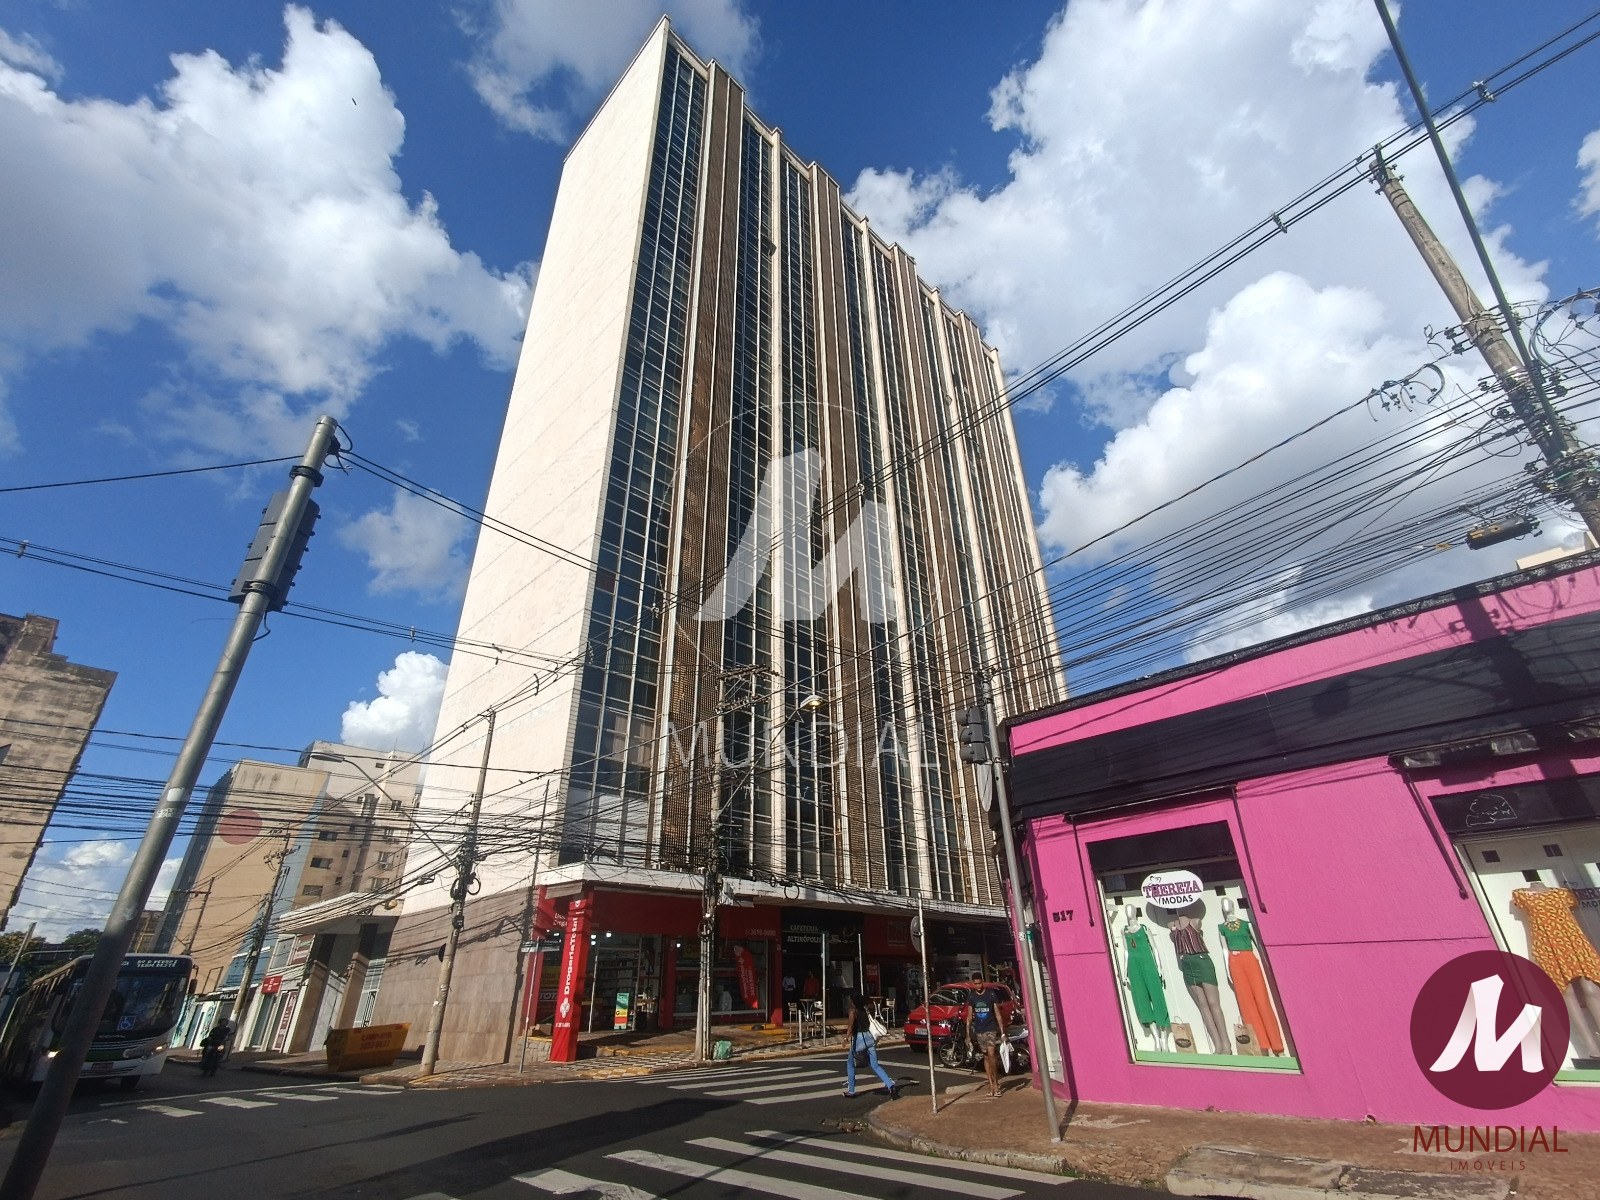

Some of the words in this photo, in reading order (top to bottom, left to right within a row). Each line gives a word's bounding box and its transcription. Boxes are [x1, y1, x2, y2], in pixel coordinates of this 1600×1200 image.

[1143, 880, 1201, 899] THEREZA
[1162, 894, 1194, 905] MODAS
[1052, 909, 1074, 923] 517
